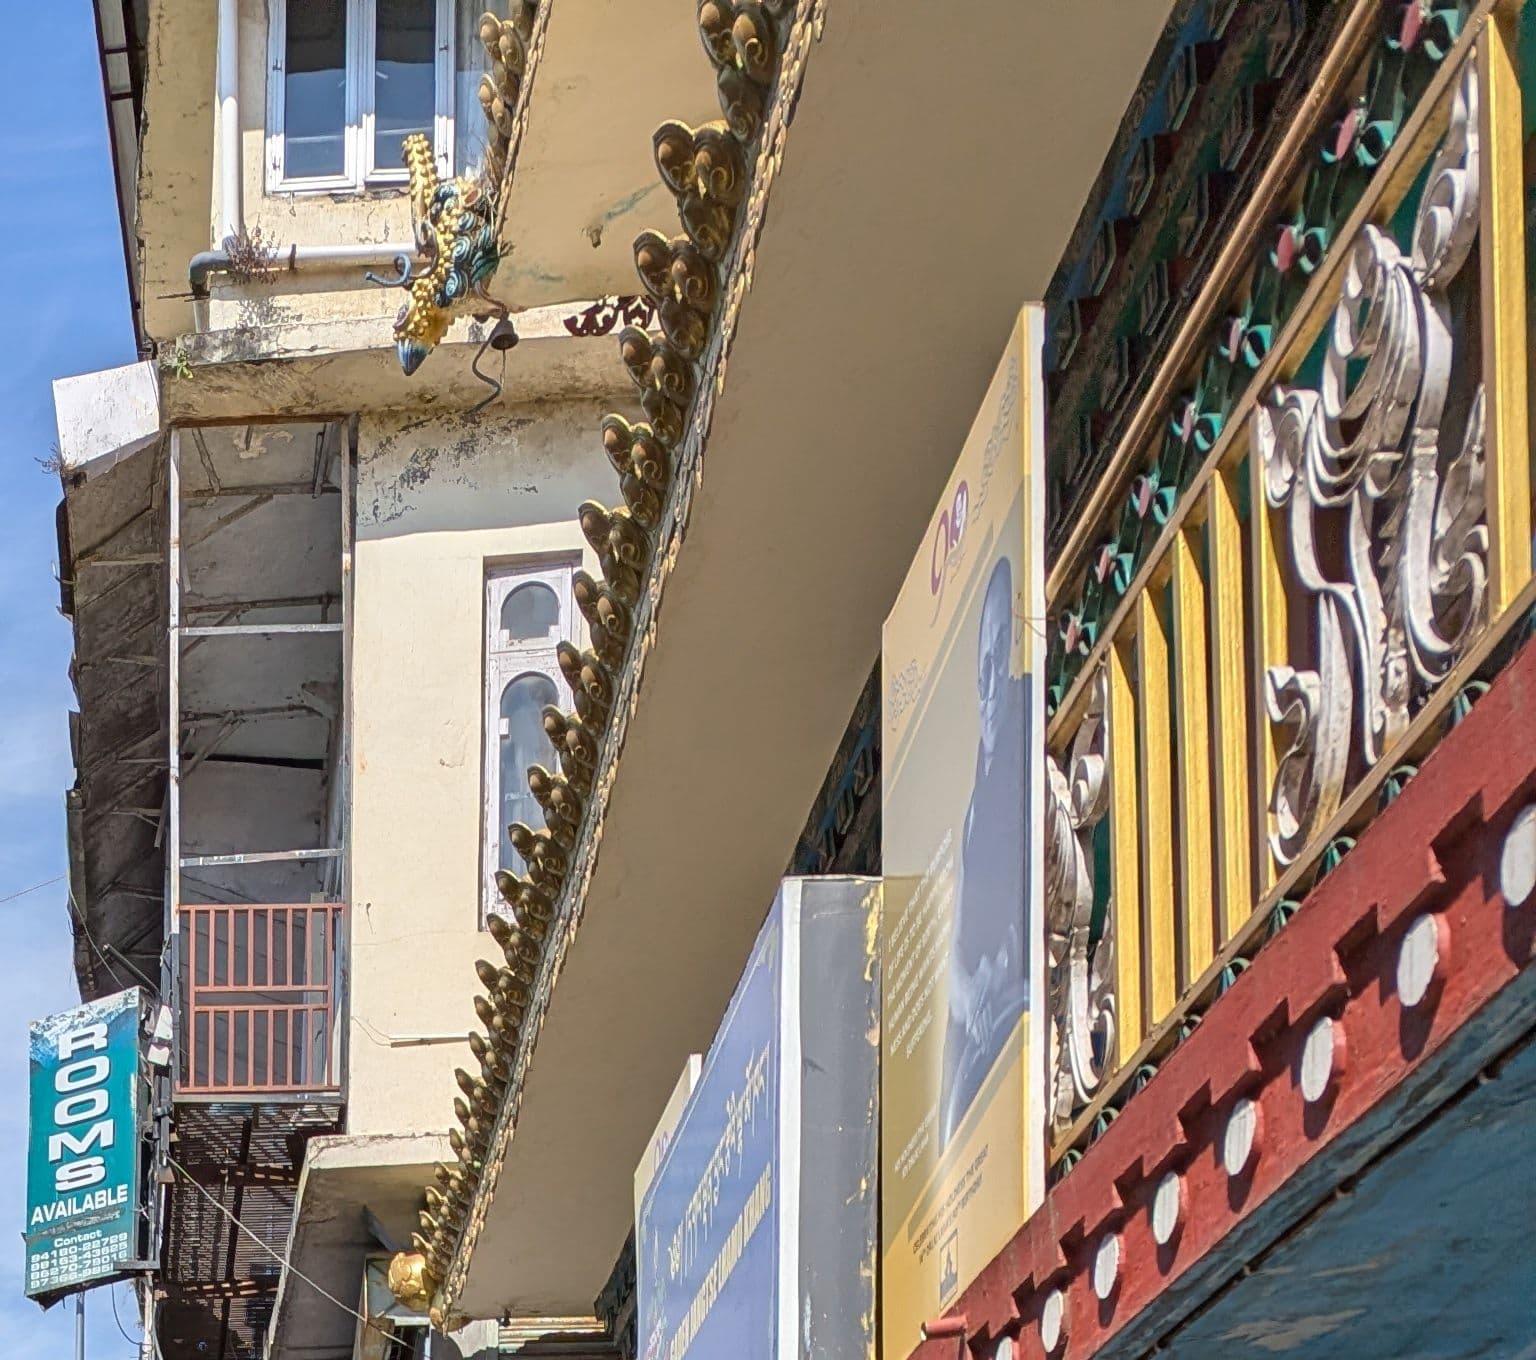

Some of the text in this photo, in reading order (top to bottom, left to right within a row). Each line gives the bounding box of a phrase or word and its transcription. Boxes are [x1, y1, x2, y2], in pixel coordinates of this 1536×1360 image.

[48, 1023, 115, 1192] ROOMS
[31, 1184, 128, 1226] AVAILABLE
[54, 1230, 102, 1248] Contact
